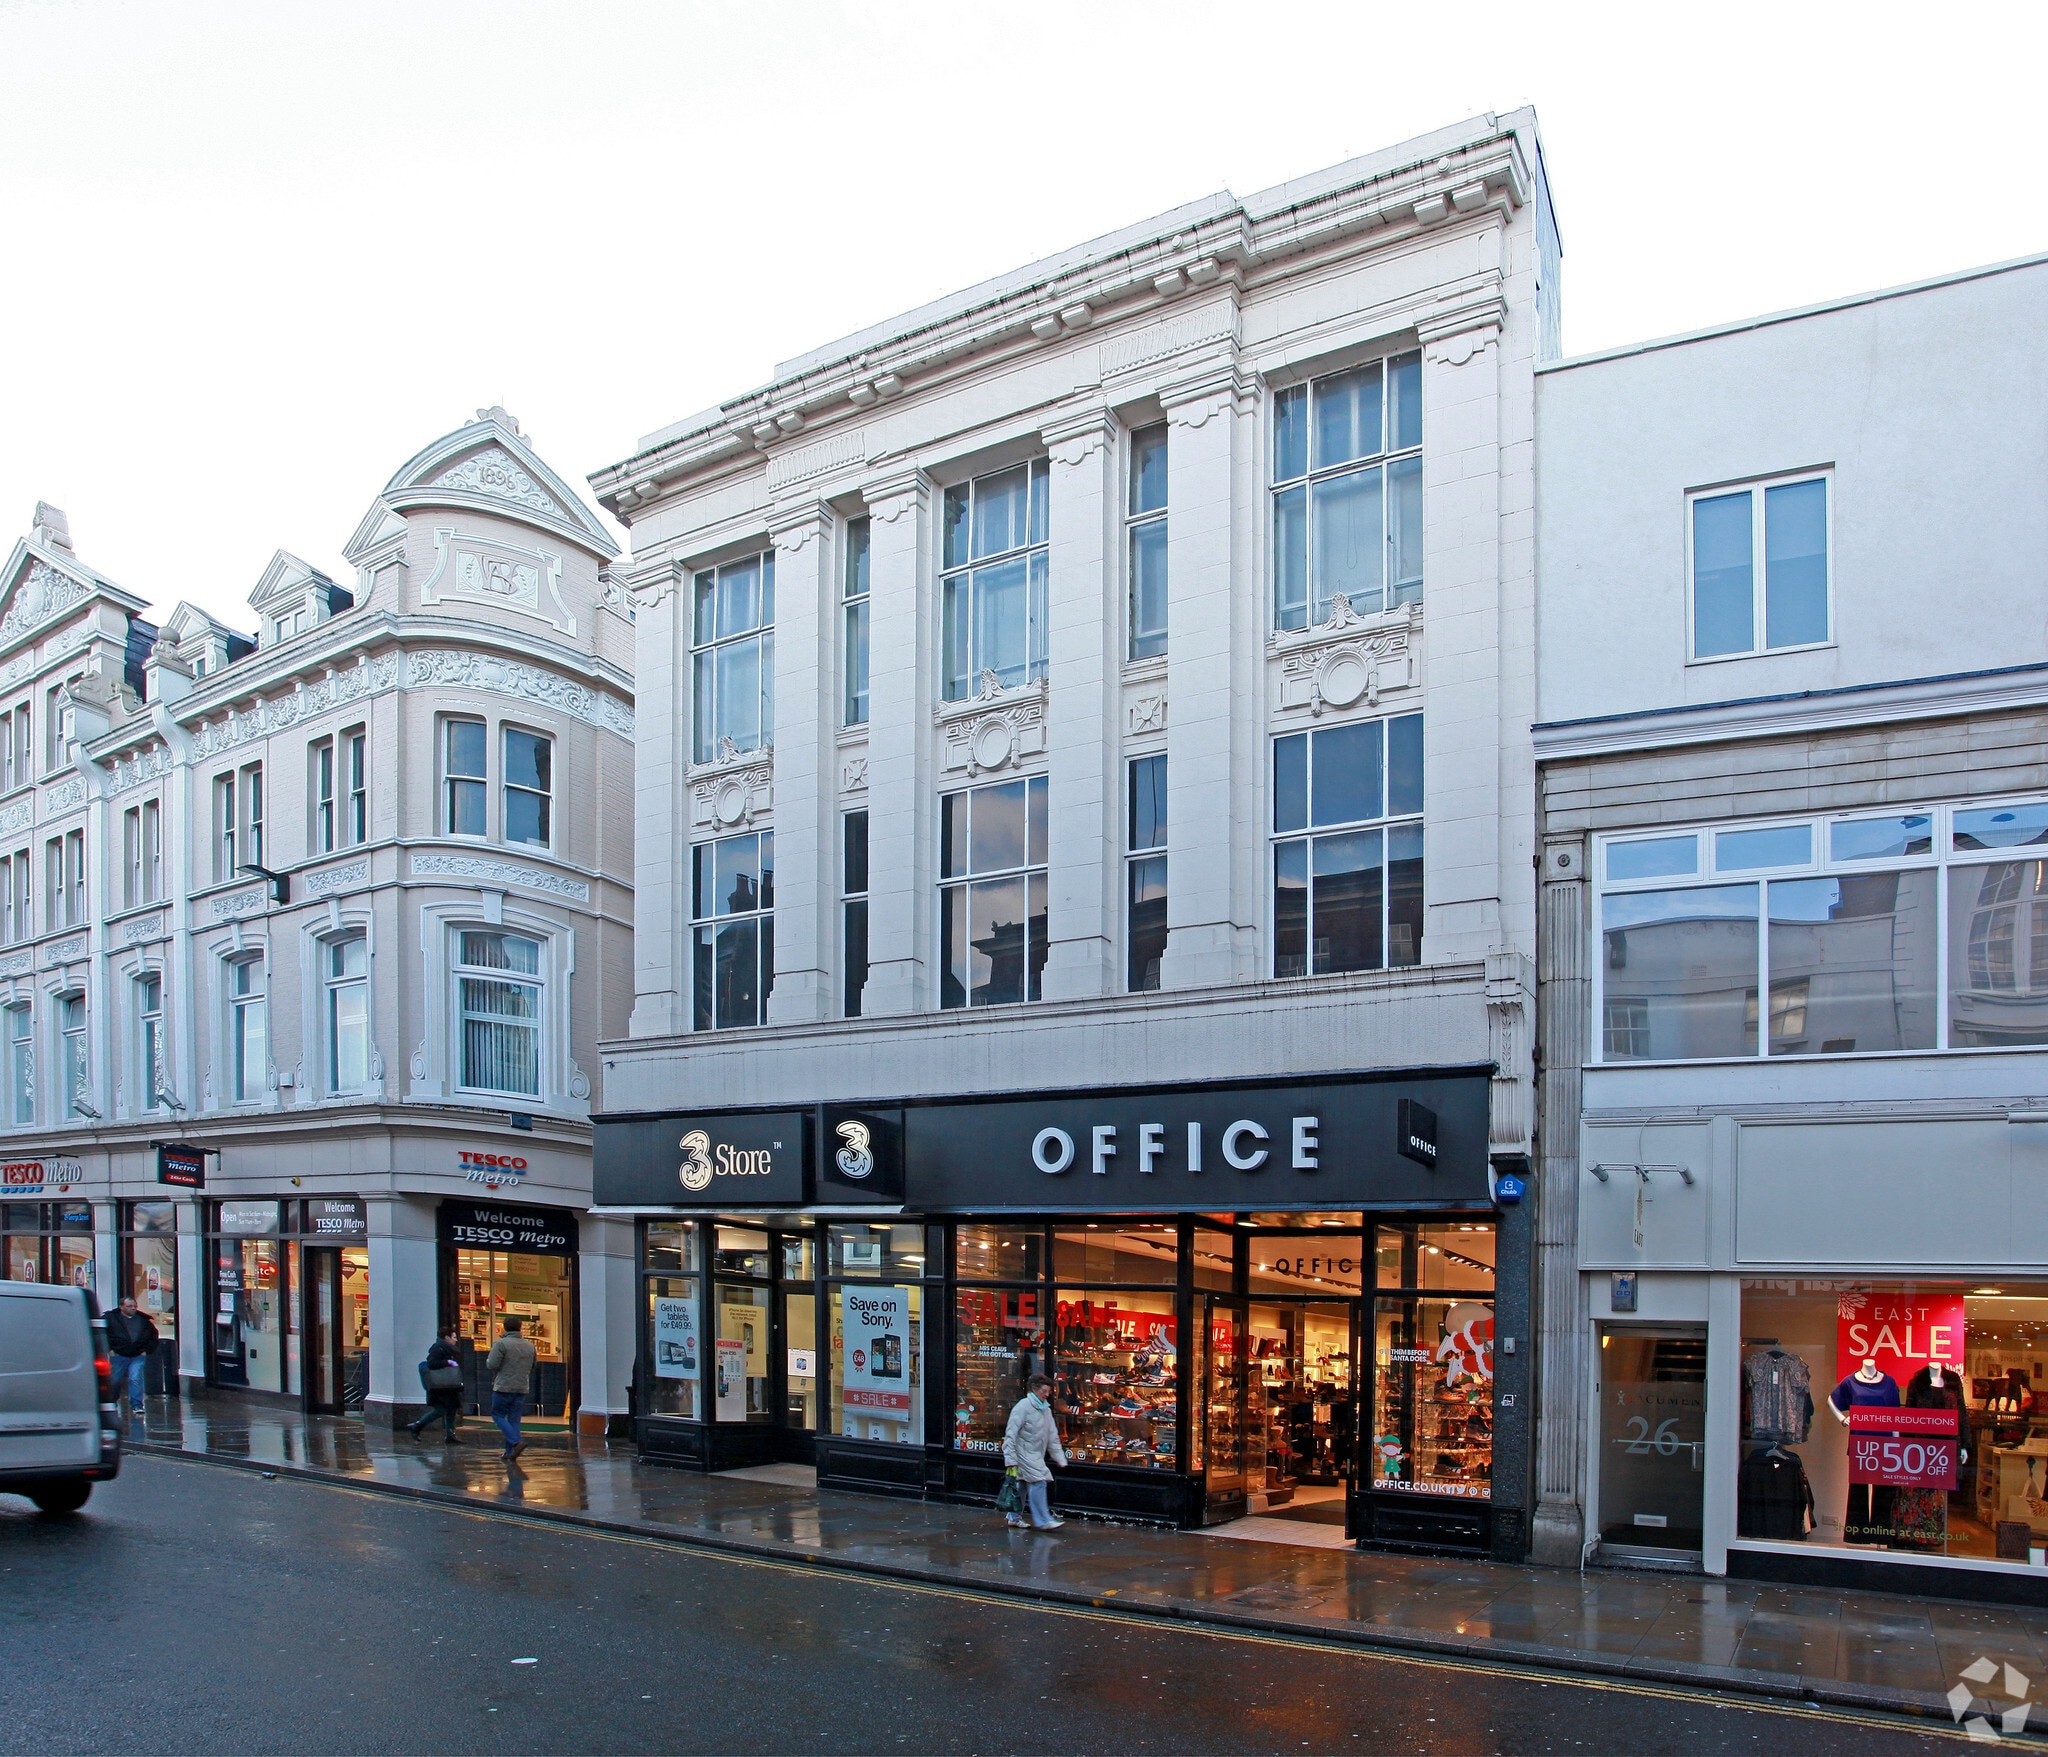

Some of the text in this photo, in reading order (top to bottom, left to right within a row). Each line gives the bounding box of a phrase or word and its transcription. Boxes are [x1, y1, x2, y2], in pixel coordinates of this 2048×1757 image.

[836, 1120, 874, 1179] 3
[1031, 1116, 1319, 1174] OFFICE
[1410, 1135, 1437, 1156] OFFICE
[167, 1163, 197, 1172] Metro
[458, 1151, 528, 1169] TESCO
[678, 1129, 714, 1192] 3
[715, 1143, 772, 1176] Store
[1, 1161, 82, 1183] TESCO Metro
[465, 1169, 519, 1186] Metro
[324, 1201, 355, 1213] Welcome
[221, 1211, 237, 1224] Open
[316, 1218, 365, 1229] TESCO Metro
[473, 1209, 545, 1228] Welcome
[453, 1225, 566, 1245] TESCO Metro
[660, 1303, 687, 1312] Get two
[850, 1296, 897, 1313] Save on
[961, 1291, 1037, 1329] SALE
[667, 1312, 689, 1321] tablets
[861, 1312, 893, 1329] Sony.
[1056, 1299, 1118, 1328] SALE
[1874, 1307, 1929, 1321] EAST
[660, 1320, 694, 1330] for £49.99.
[1849, 1323, 1952, 1359] SALE
[854, 1354, 865, 1363] £48
[861, 1392, 889, 1407] SALE
[1852, 1414, 1955, 1426] FURTHER REDUCTIONS
[1625, 1416, 1679, 1456] 26
[1855, 1456, 1880, 1471] TO
[1857, 1440, 1949, 1474] UP 50%
[1927, 1466, 1948, 1476] OFF
[1373, 1479, 1446, 1493] OFFICE.CO.UK
[1862, 1525, 1896, 1536] online
[1899, 1530, 1911, 1538] at
[1913, 1530, 1969, 1542] east.co.uk
